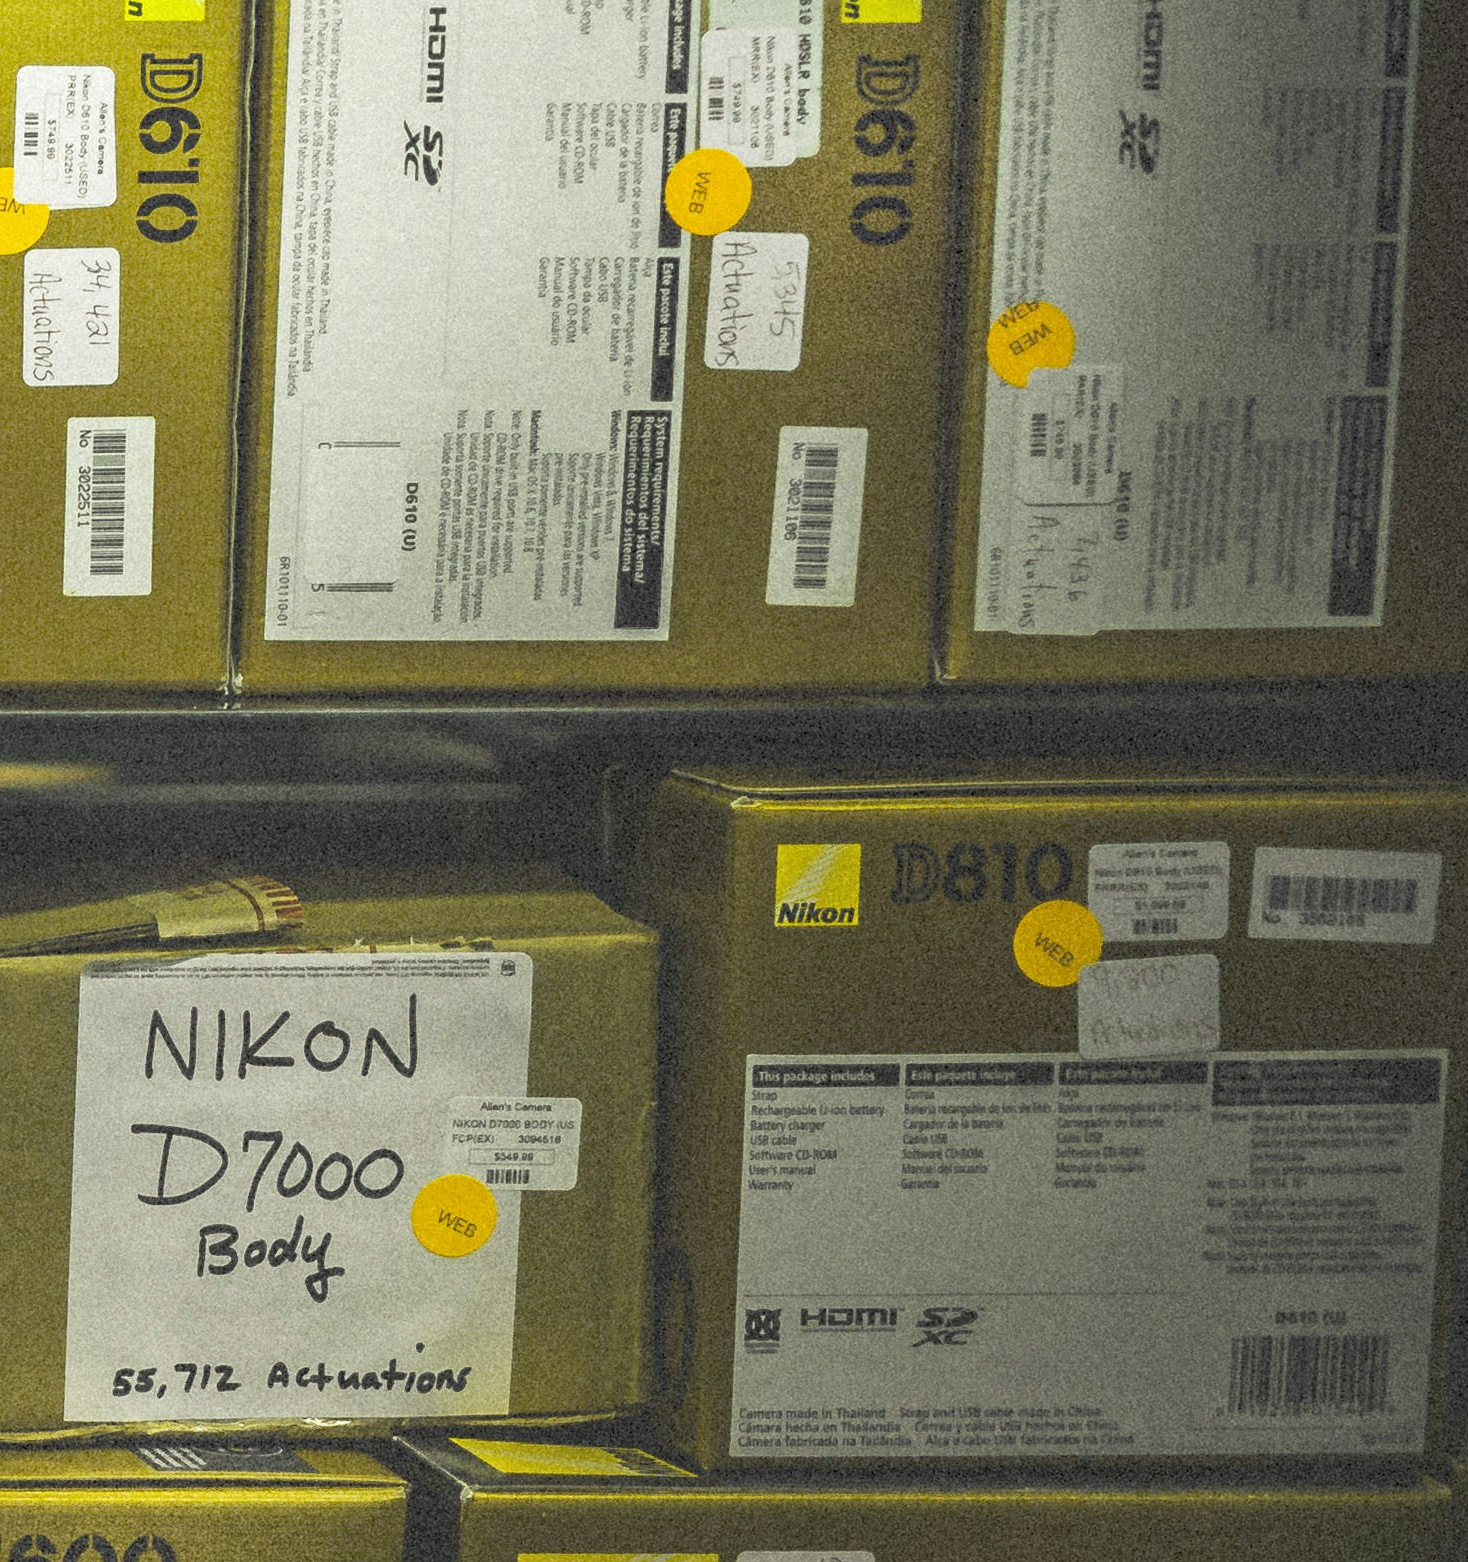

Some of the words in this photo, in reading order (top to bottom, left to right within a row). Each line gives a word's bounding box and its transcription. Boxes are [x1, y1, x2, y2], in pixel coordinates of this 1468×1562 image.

[426, 6, 447, 104] HDMI
[137, 52, 204, 243] D610
[848, 53, 922, 248] D610
[29, 272, 55, 383] Actuations
[778, 902, 855, 925] Nikon
[889, 842, 1074, 903] D810
[144, 995, 418, 1081] NIKON
[131, 1124, 404, 1212] D7000
[197, 1214, 345, 1302] Body
[112, 1362, 240, 1398] 55,712
[268, 1342, 470, 1393] Actuations
